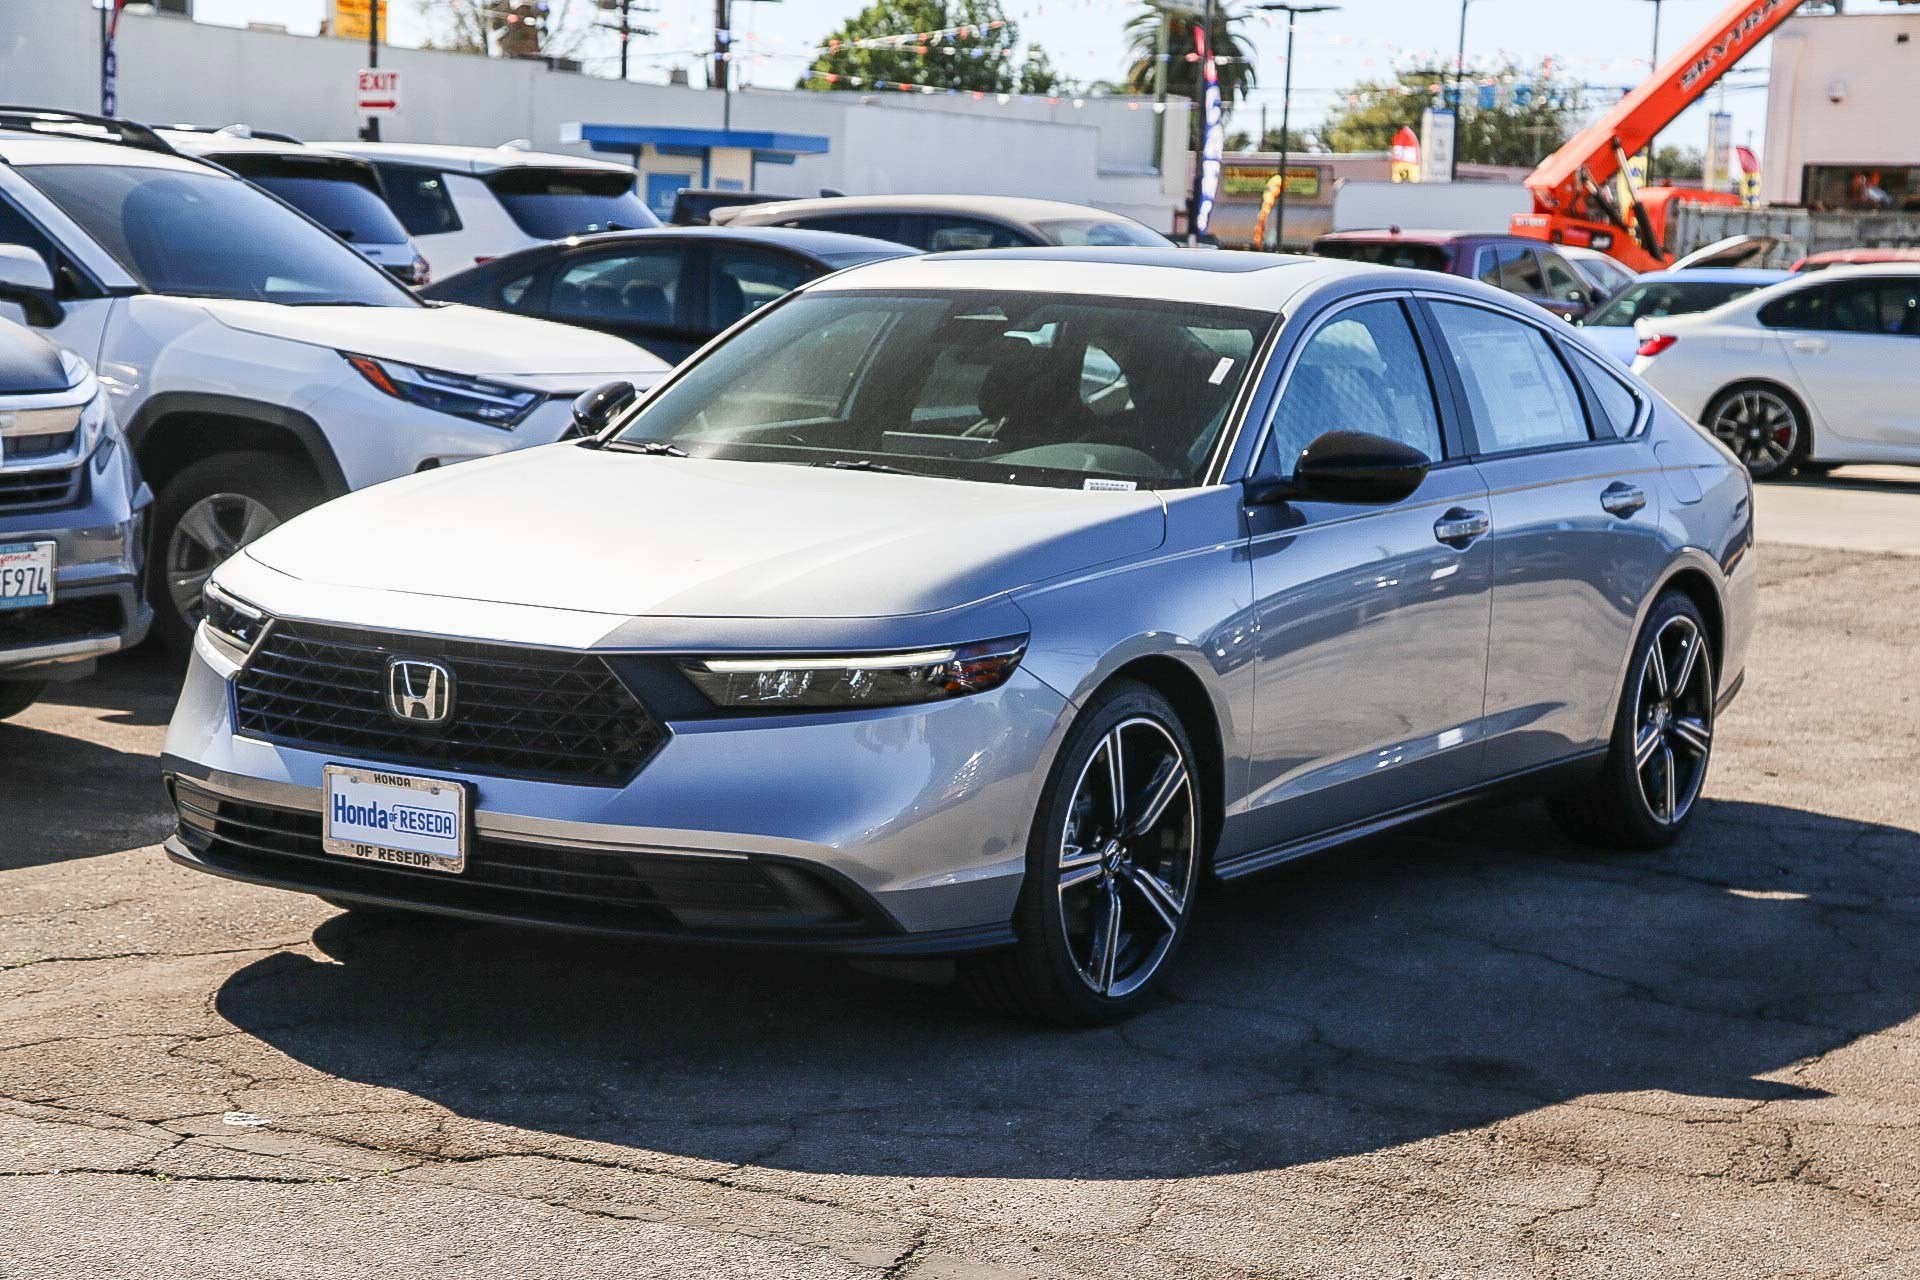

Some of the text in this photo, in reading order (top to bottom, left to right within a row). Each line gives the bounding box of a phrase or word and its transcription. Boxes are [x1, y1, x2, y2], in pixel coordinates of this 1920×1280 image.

[359, 72, 397, 91] EXIT
[0, 567, 47, 597] F974
[373, 773, 412, 788] HONDA
[333, 793, 452, 835] Honda OF RESEDA
[355, 844, 431, 868] OF RESEDA
